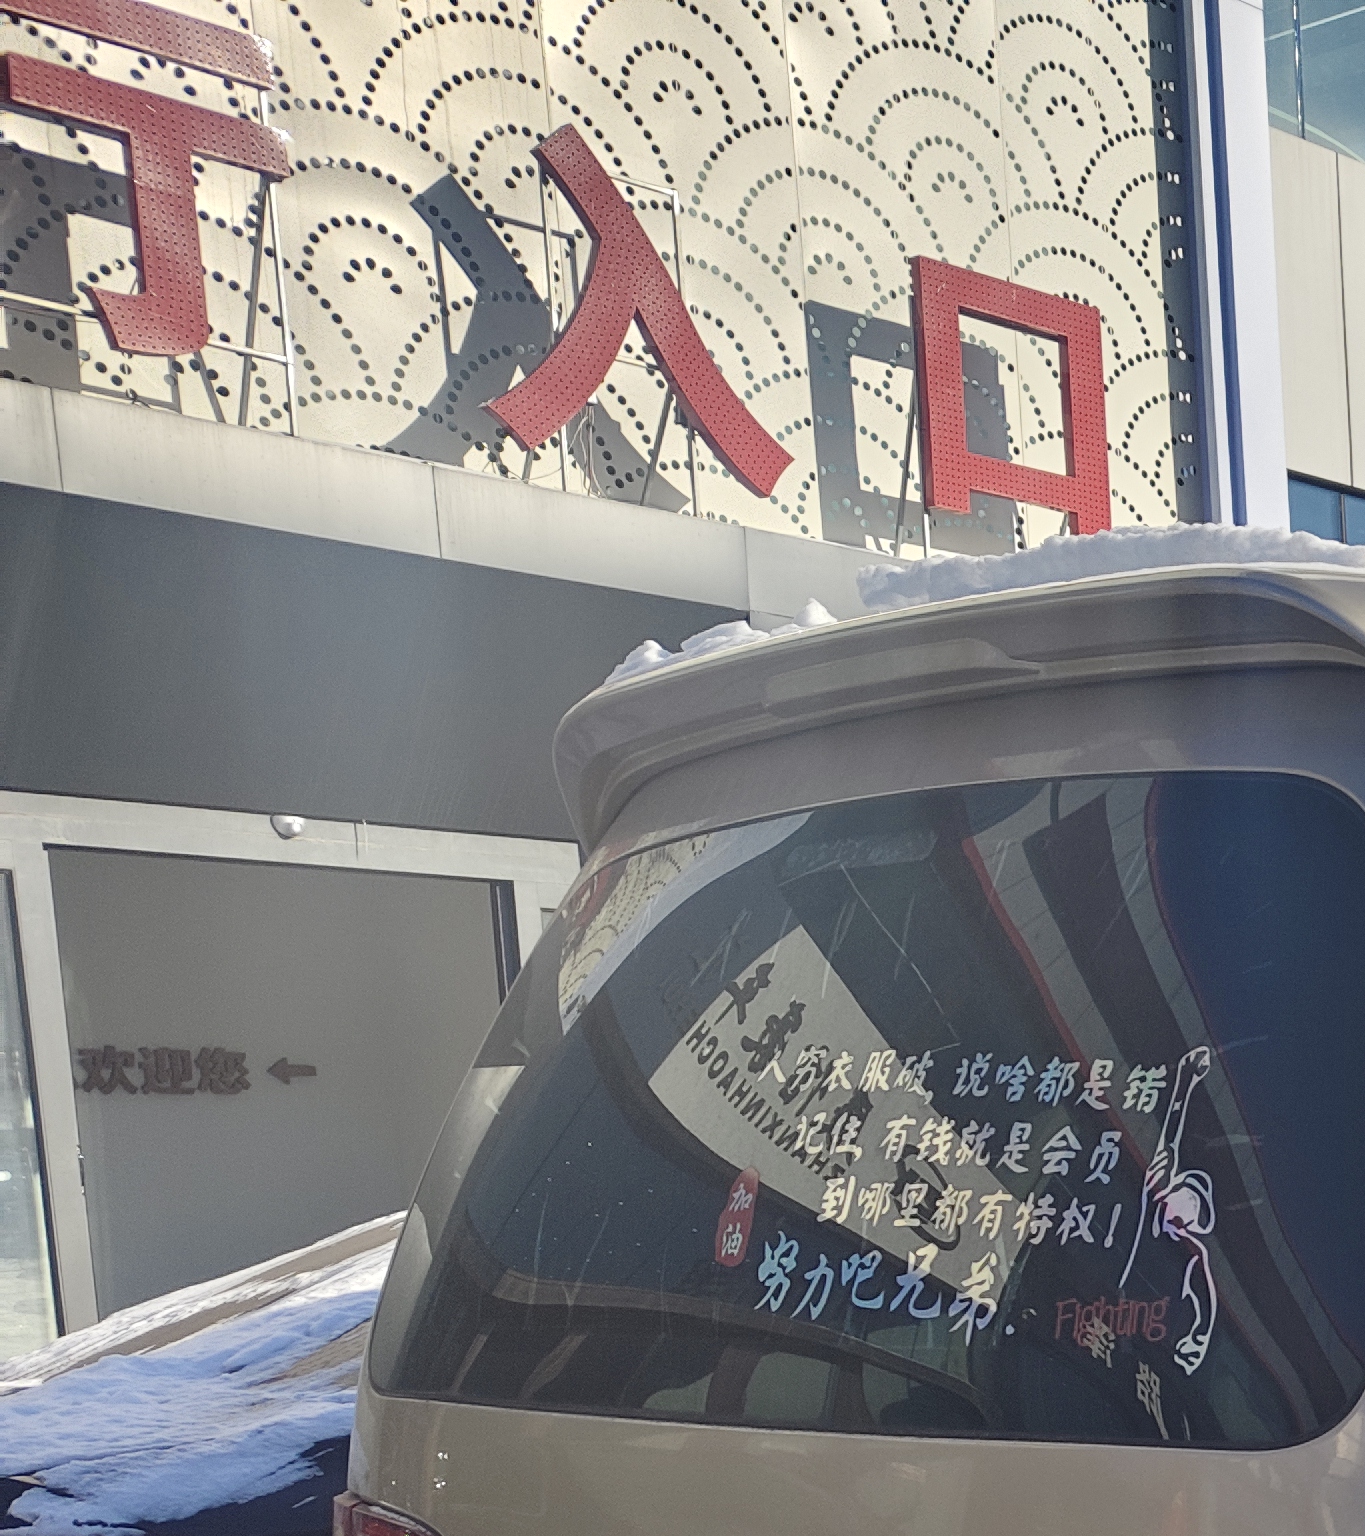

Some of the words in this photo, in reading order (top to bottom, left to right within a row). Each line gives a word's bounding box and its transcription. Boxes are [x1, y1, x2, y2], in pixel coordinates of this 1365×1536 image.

[76, 1045, 251, 1095] 欢迎您
[721, 1183, 753, 1257] 加油
[1055, 1296, 1171, 1347] Fighting
